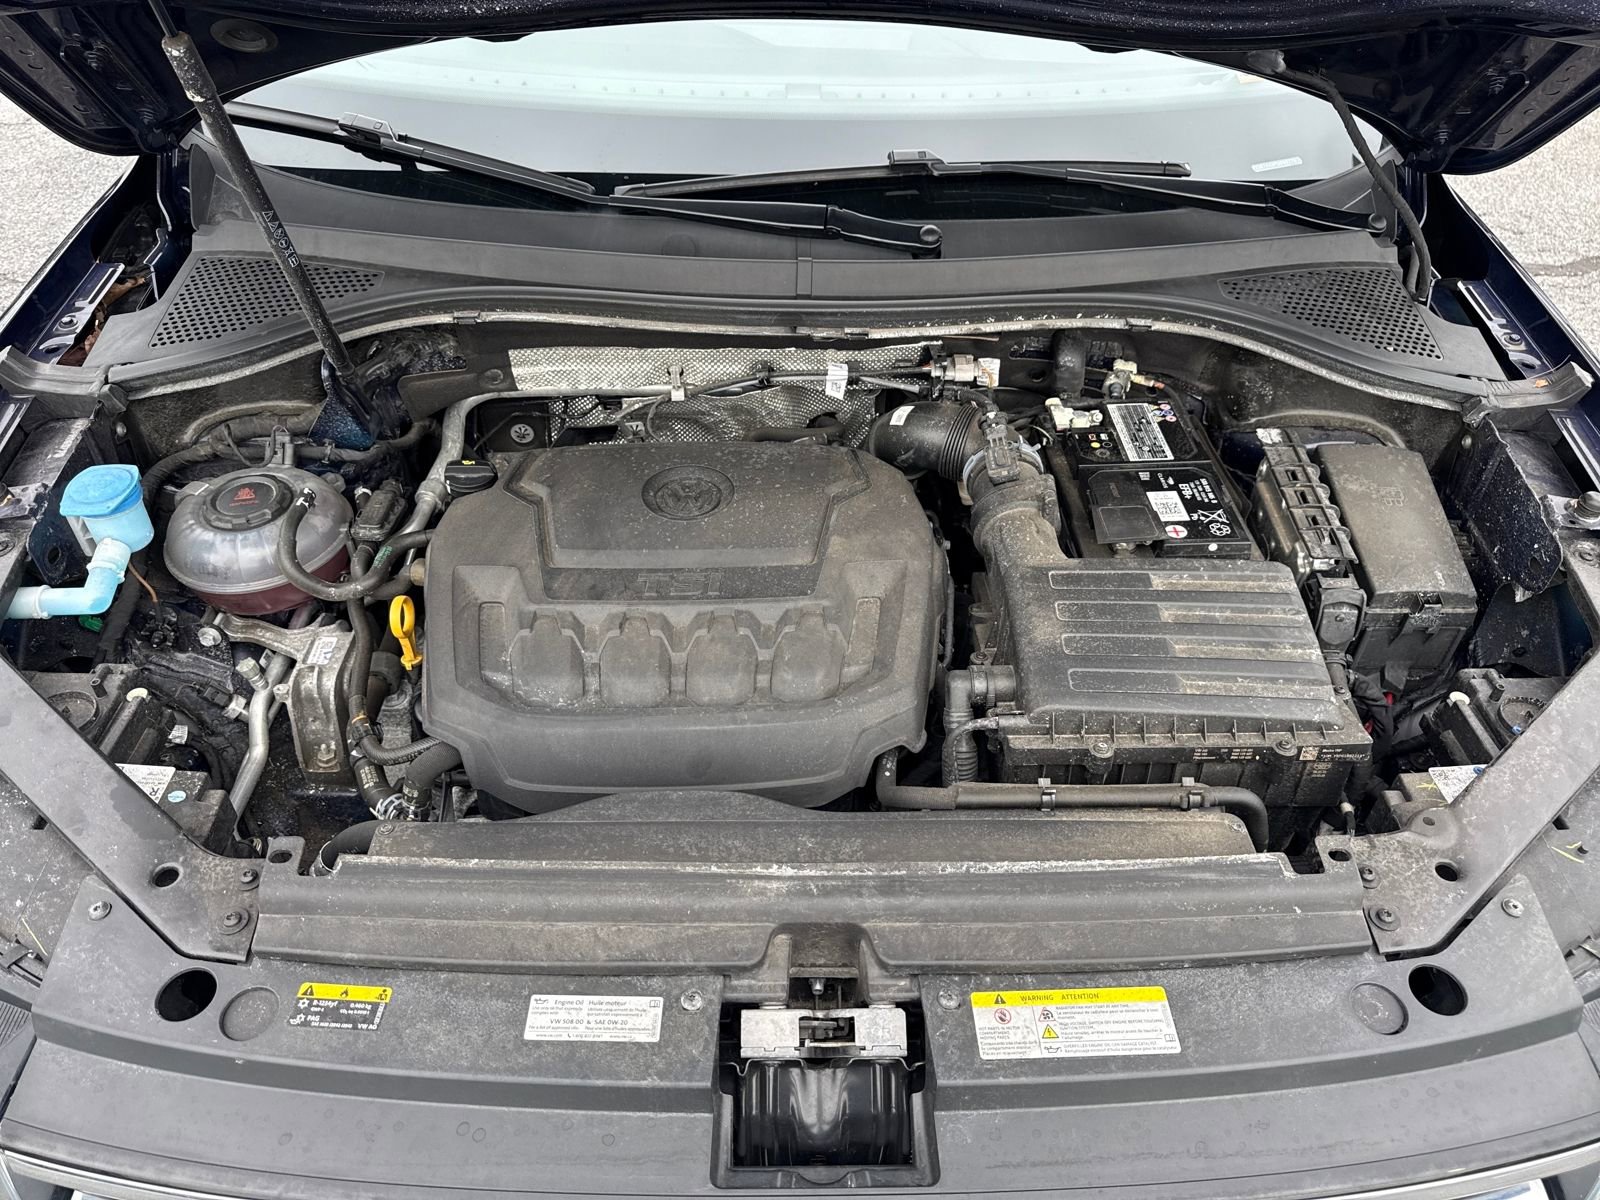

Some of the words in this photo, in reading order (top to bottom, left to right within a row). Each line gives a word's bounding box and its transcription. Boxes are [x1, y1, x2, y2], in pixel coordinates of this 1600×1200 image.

[1178, 483, 1193, 500] EFB+
[637, 571, 721, 596] TSI
[1020, 994, 1054, 1002] WARNING
